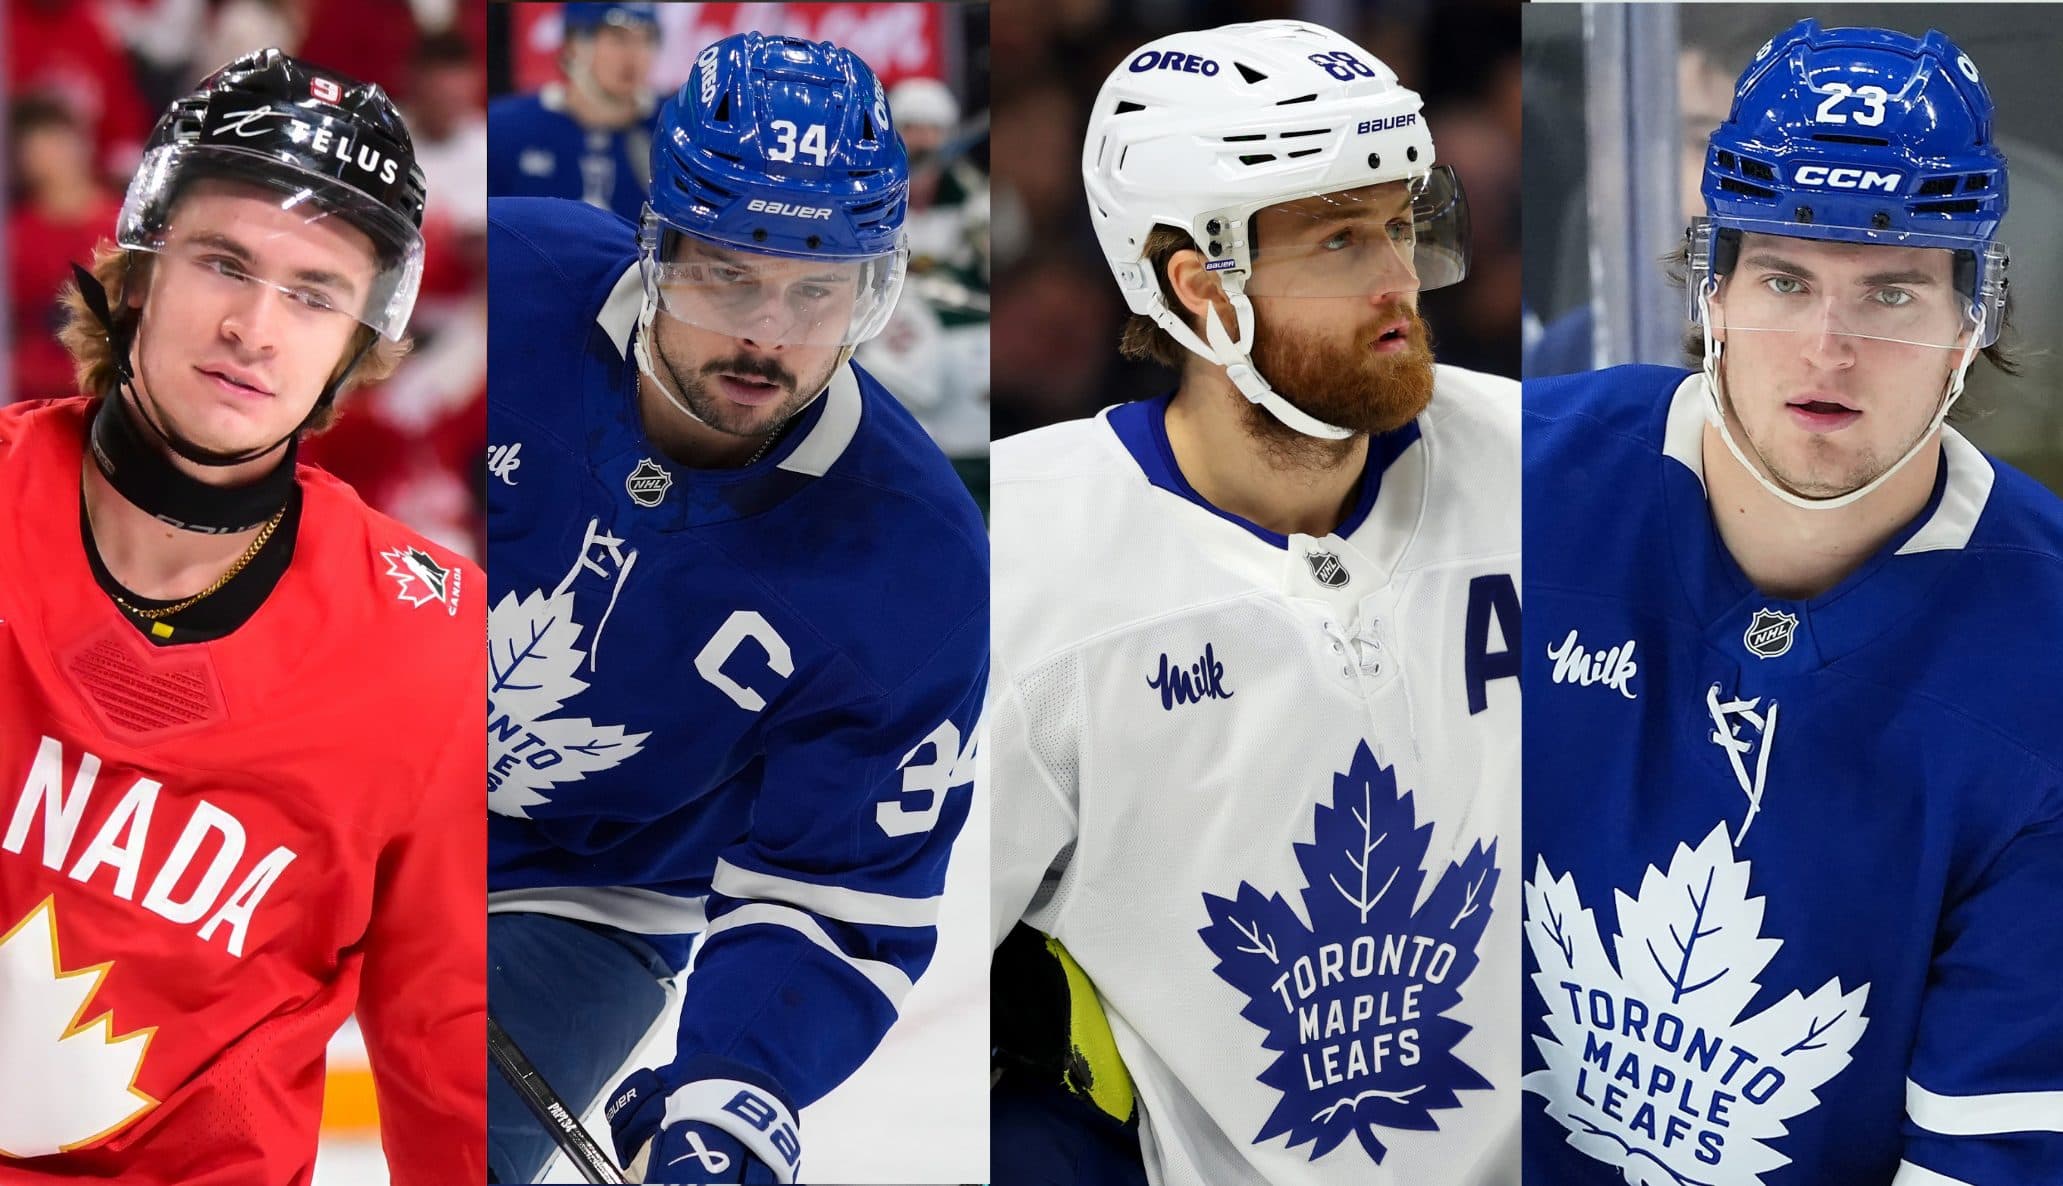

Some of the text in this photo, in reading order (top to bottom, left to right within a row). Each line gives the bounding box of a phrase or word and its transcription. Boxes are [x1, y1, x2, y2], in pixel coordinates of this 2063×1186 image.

[698, 46, 719, 103] OREO
[1128, 50, 1220, 77] OREO
[1308, 51, 1376, 82] 88
[310, 76, 342, 105] 9
[1815, 82, 1887, 127] 23
[767, 119, 828, 167] 34
[1357, 113, 1416, 135] BAUER
[290, 118, 398, 184] TELUS
[1794, 166, 1902, 192] CCM
[747, 199, 833, 221] BAUER
[488, 443, 522, 486] lk
[634, 478, 662, 491] NHL
[448, 567, 461, 616] CANADA
[1318, 558, 1338, 581] NHL
[1465, 573, 1522, 716] A
[1755, 624, 1788, 646] NHL
[694, 610, 795, 712] C
[1147, 642, 1234, 711] Milk
[1547, 630, 1637, 699] Milk
[1271, 934, 1456, 1014] TORONTO
[1298, 984, 1423, 1045] MAPLE
[1302, 1028, 1420, 1091] LEAFS
[1560, 981, 1785, 1105] TORONTO
[1583, 1030, 1737, 1127] MAPLE
[606, 1087, 637, 1124] AUER
[1576, 1068, 1724, 1165] LEAFS
